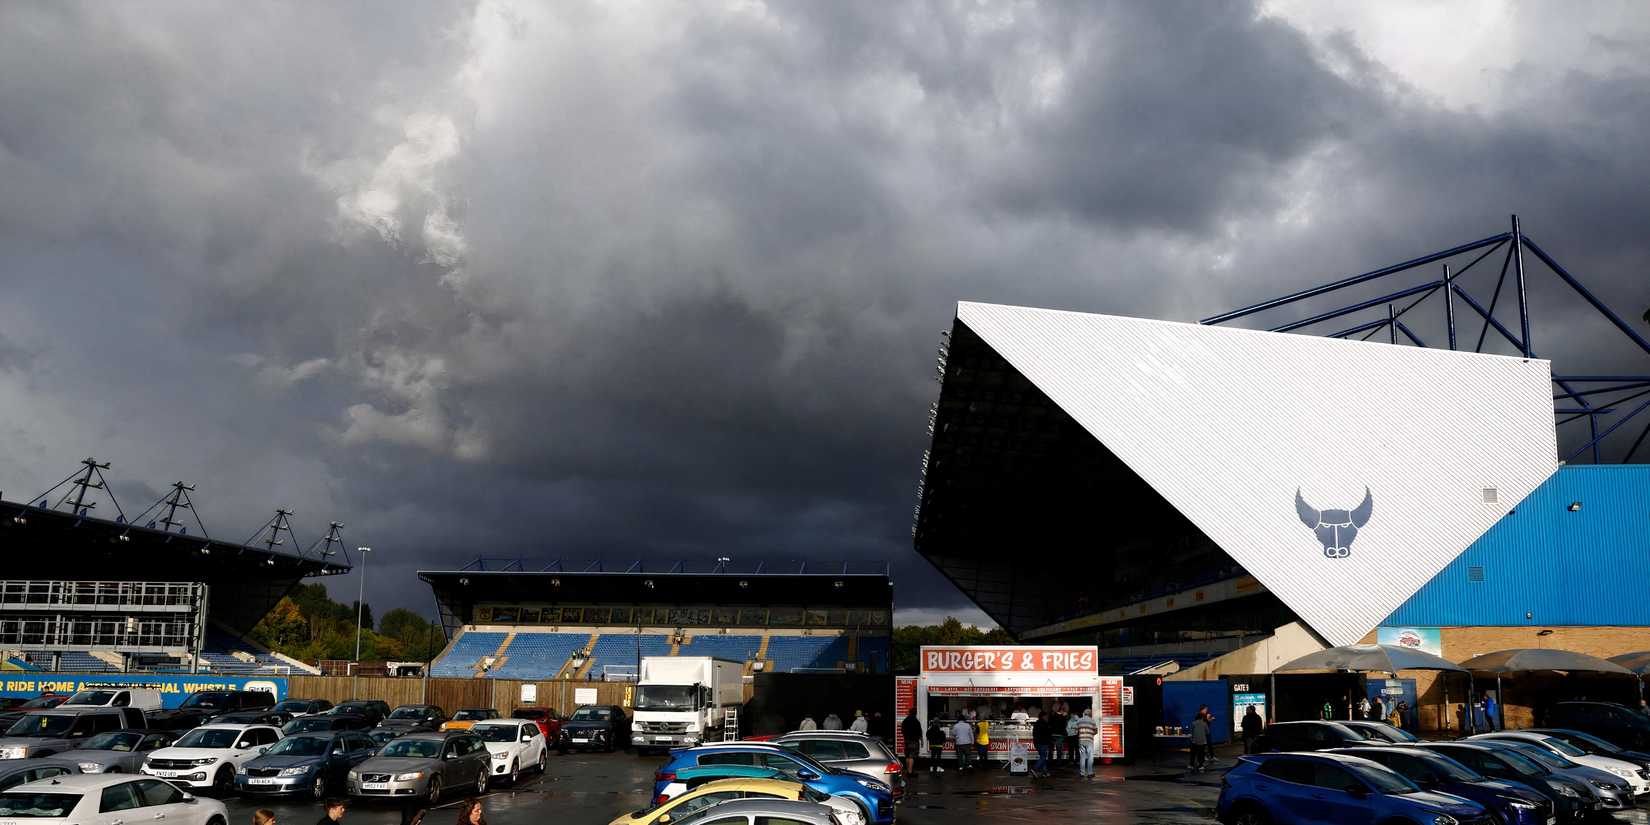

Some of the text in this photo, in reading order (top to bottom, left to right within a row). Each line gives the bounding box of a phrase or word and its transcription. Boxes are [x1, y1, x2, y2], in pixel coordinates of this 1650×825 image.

[928, 652, 1092, 670] BURGER'S & FRIES
[7, 681, 34, 692] RIDE
[38, 681, 74, 692] HOME
